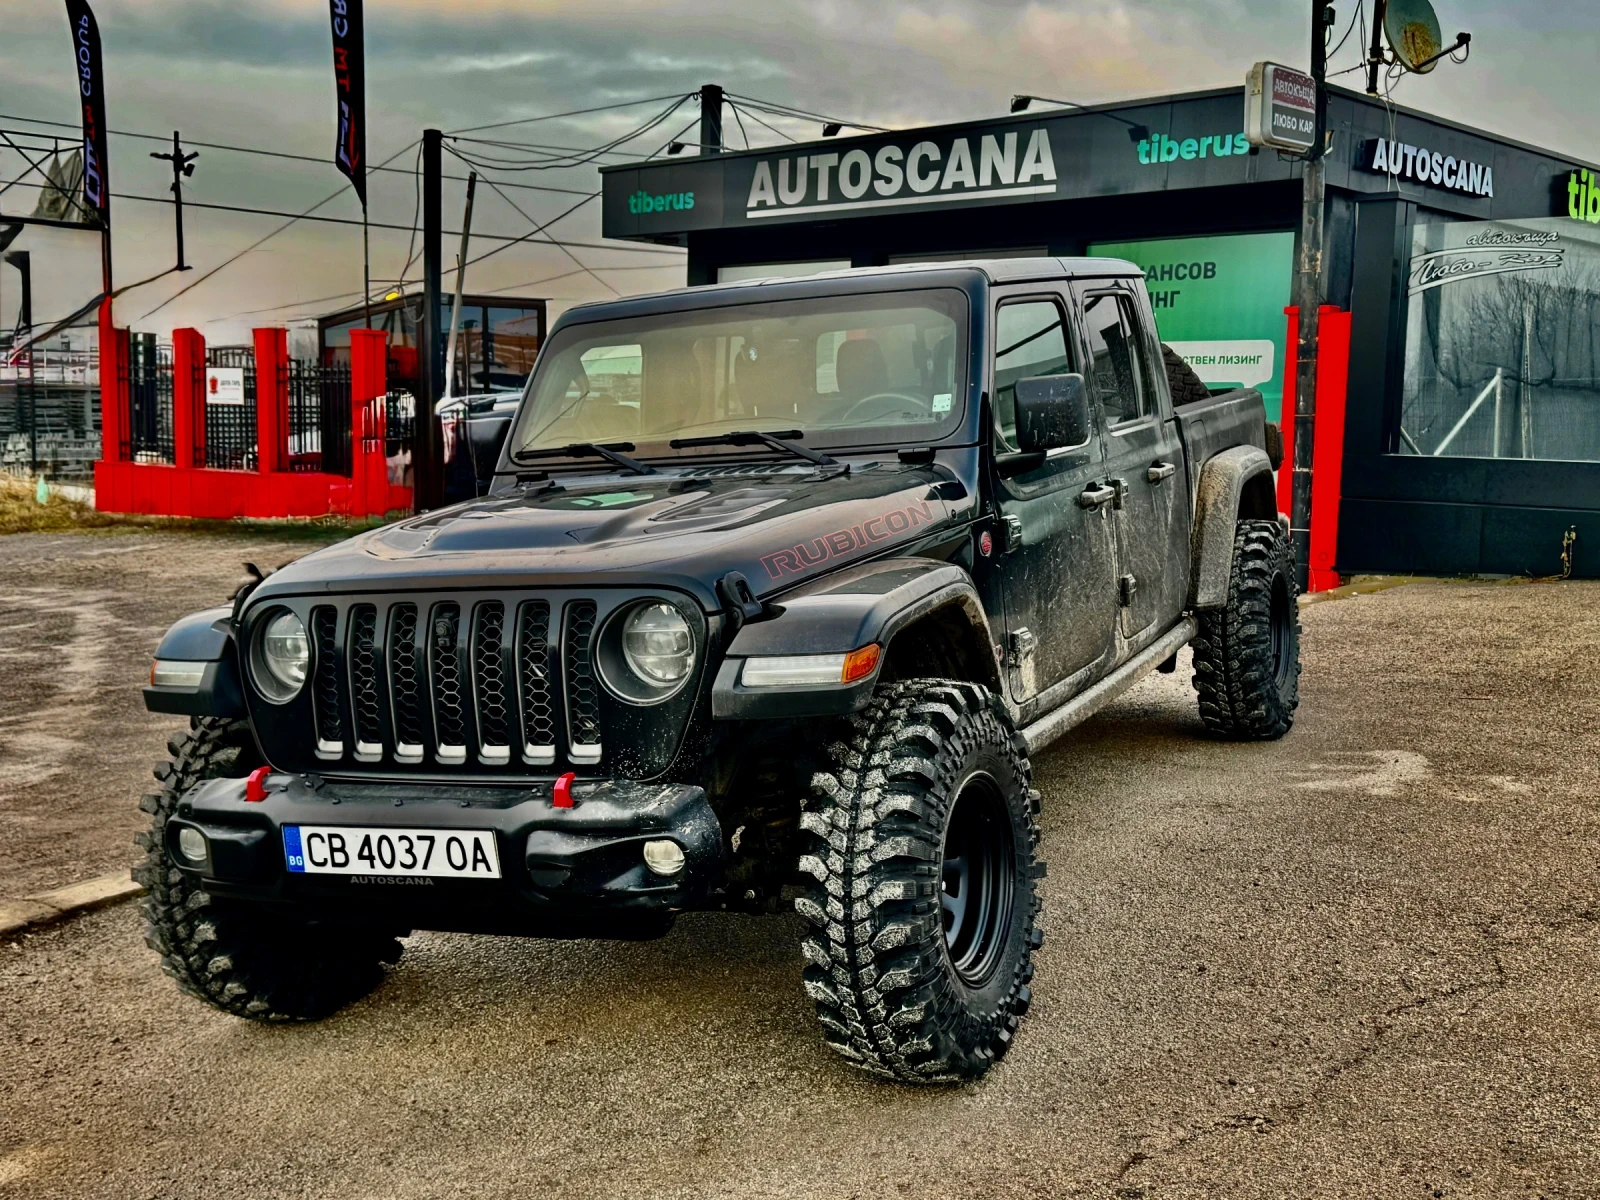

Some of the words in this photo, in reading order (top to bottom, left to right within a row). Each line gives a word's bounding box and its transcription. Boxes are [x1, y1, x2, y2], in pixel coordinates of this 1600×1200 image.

[1274, 78, 1315, 104] АВТОКЪЩА
[1273, 113, 1297, 131] ЛЮБО
[1299, 118, 1314, 134] КАР
[1136, 133, 1250, 165] tiberus
[747, 128, 1058, 208] AUTOSCANA
[1372, 137, 1494, 198] AUTOSCANA
[628, 190, 695, 215] tiberus
[1568, 168, 1600, 224] tib
[1466, 228, 1560, 246] автокъща
[1141, 262, 1217, 282] АНСОВ
[1411, 257, 1475, 285] Любо
[1217, 355, 1263, 365] ЛИЗИНГ
[760, 500, 935, 579] RUBICON
[289, 856, 303, 867] BG
[306, 832, 350, 868] CB
[357, 833, 436, 870] 4037
[445, 836, 492, 872] OA
[350, 875, 434, 886] AUTOSCANA
